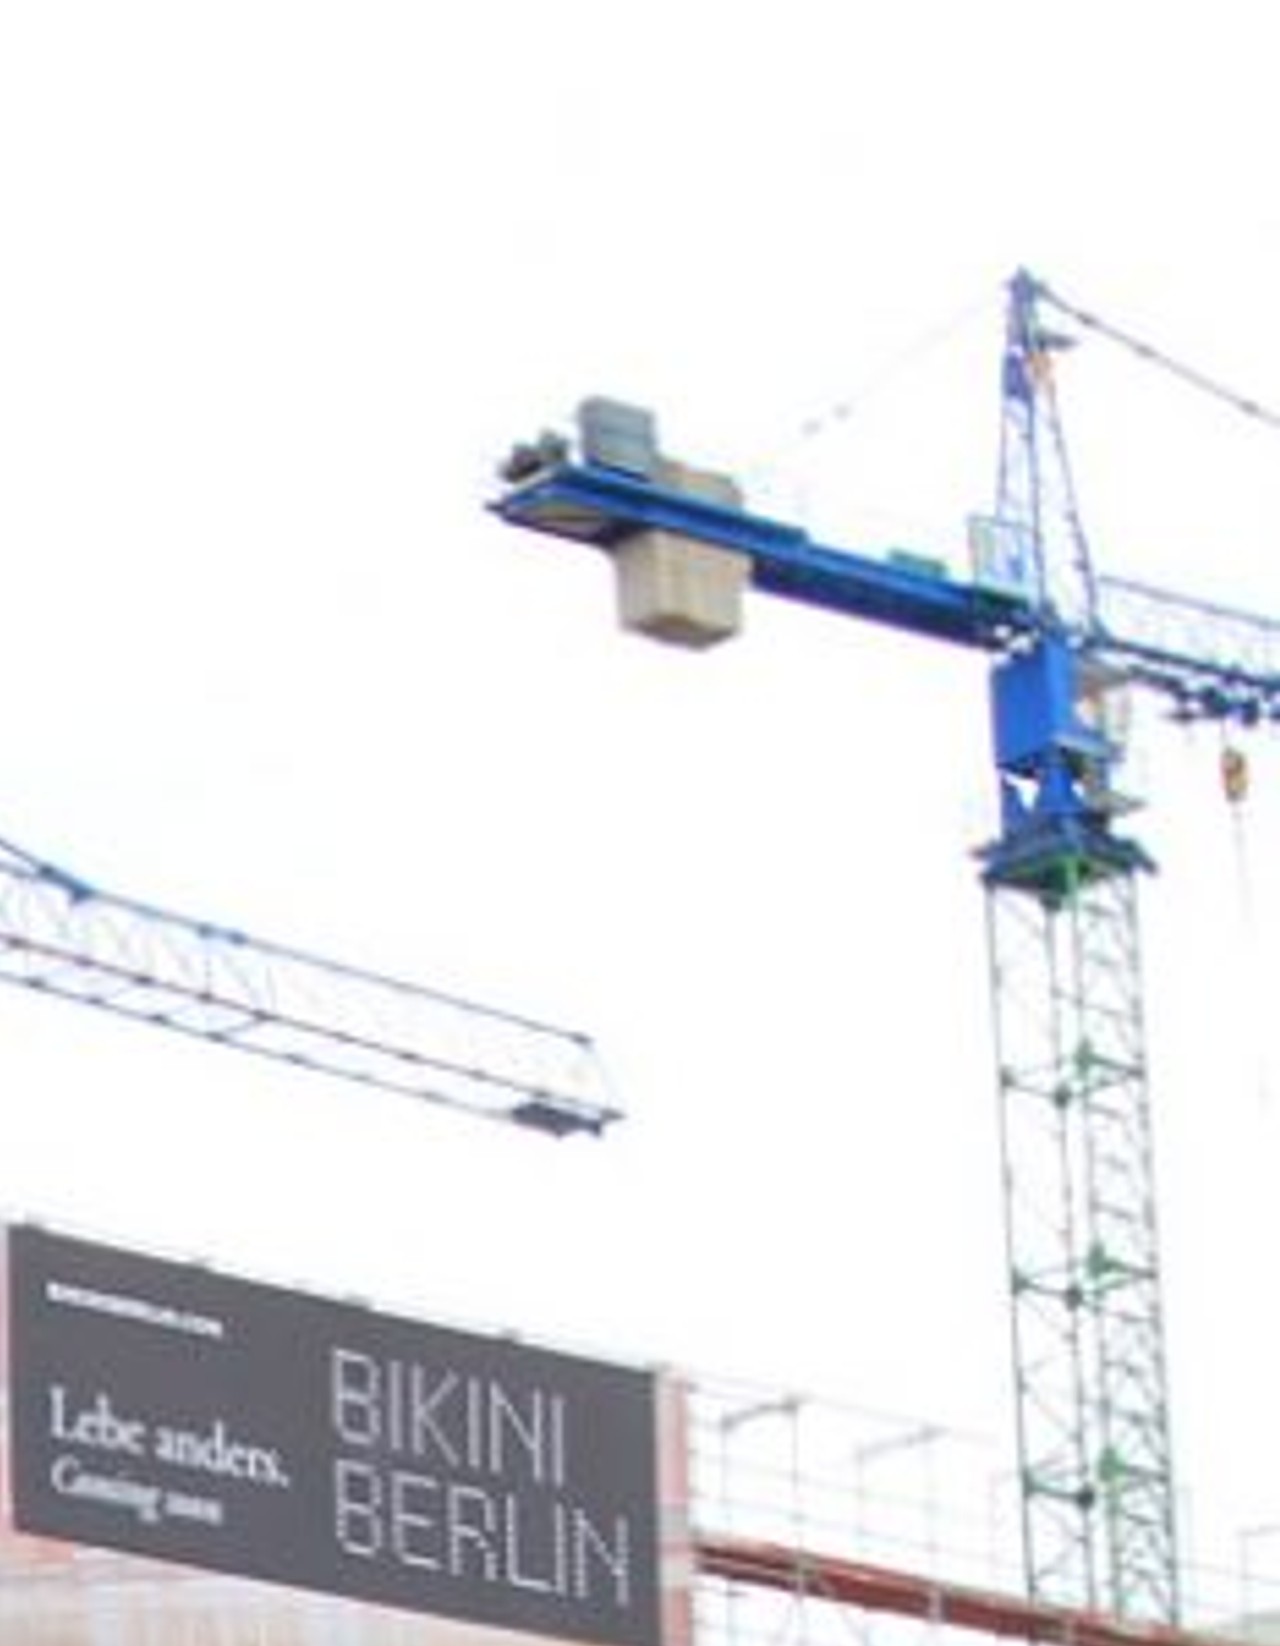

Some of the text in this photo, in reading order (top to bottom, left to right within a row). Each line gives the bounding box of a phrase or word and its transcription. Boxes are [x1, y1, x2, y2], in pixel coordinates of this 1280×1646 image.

[50, 1385, 290, 1489] Lebe anders.
[333, 1346, 565, 1488] BIKINI
[334, 1457, 629, 1605] BERLIN
